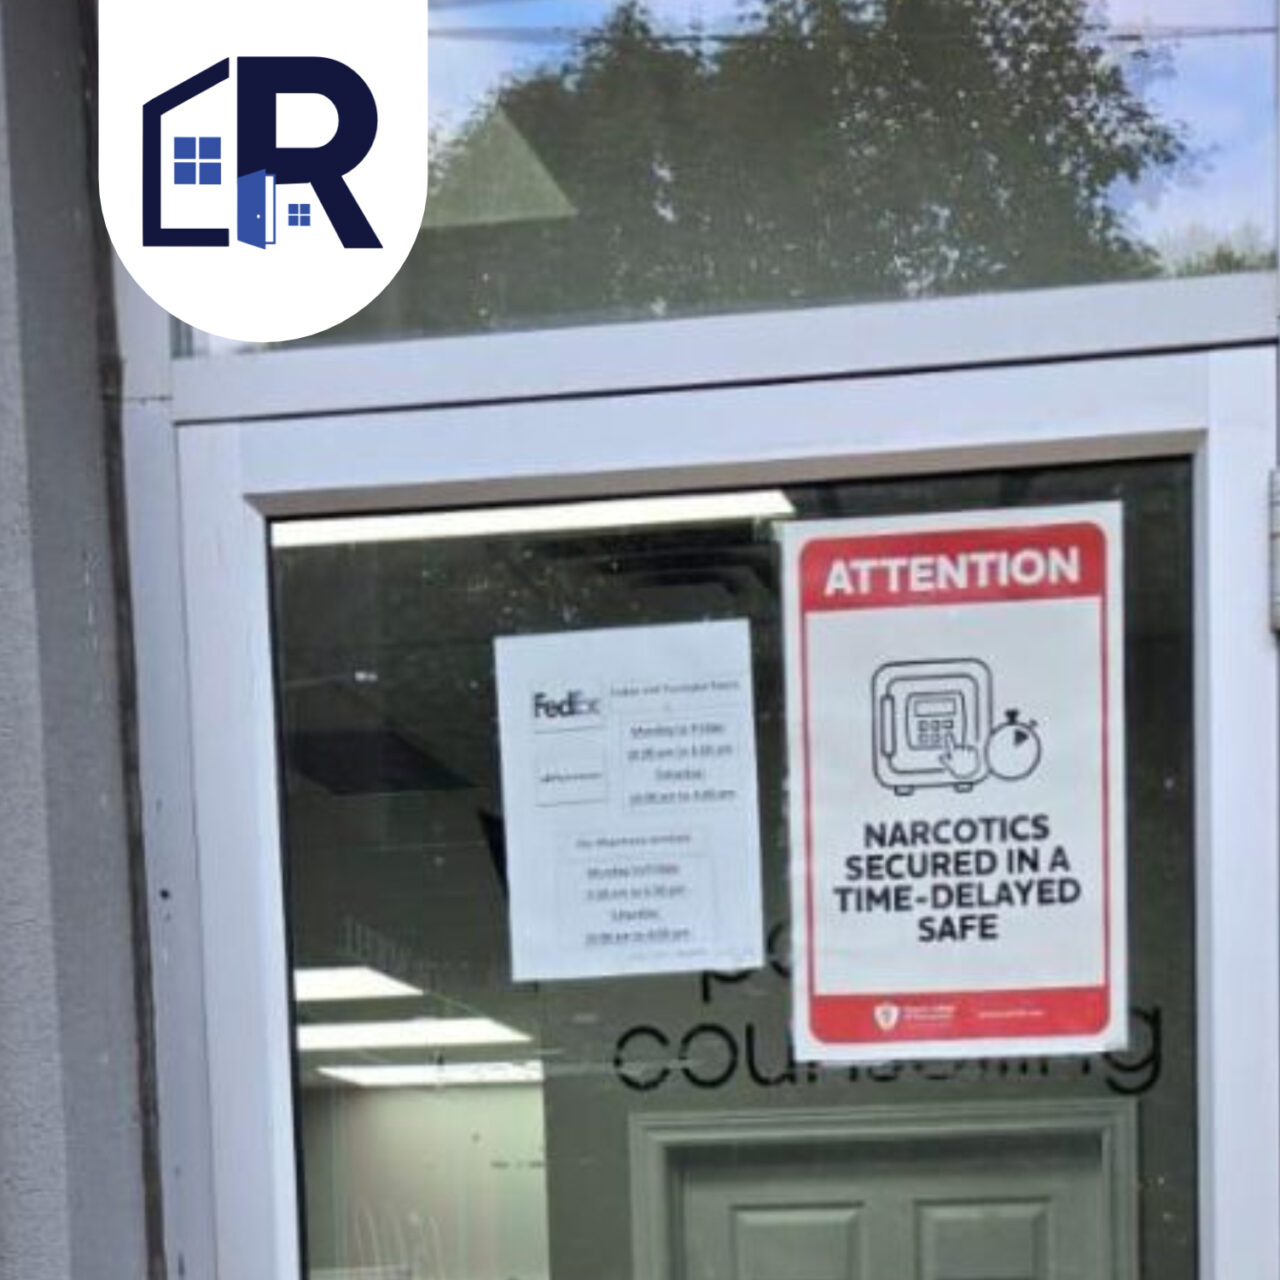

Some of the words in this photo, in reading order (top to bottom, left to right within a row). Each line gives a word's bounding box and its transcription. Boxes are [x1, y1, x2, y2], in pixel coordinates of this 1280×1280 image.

[825, 546, 1081, 597] ATTENTION
[534, 689, 602, 718] FedEx
[864, 814, 1050, 848] NARCOTICS
[845, 850, 998, 881] SECURED
[1007, 847, 1040, 874] IN
[1049, 846, 1071, 873] A
[833, 877, 1082, 913] TIME-DELAYED
[918, 913, 999, 942] SAFE
